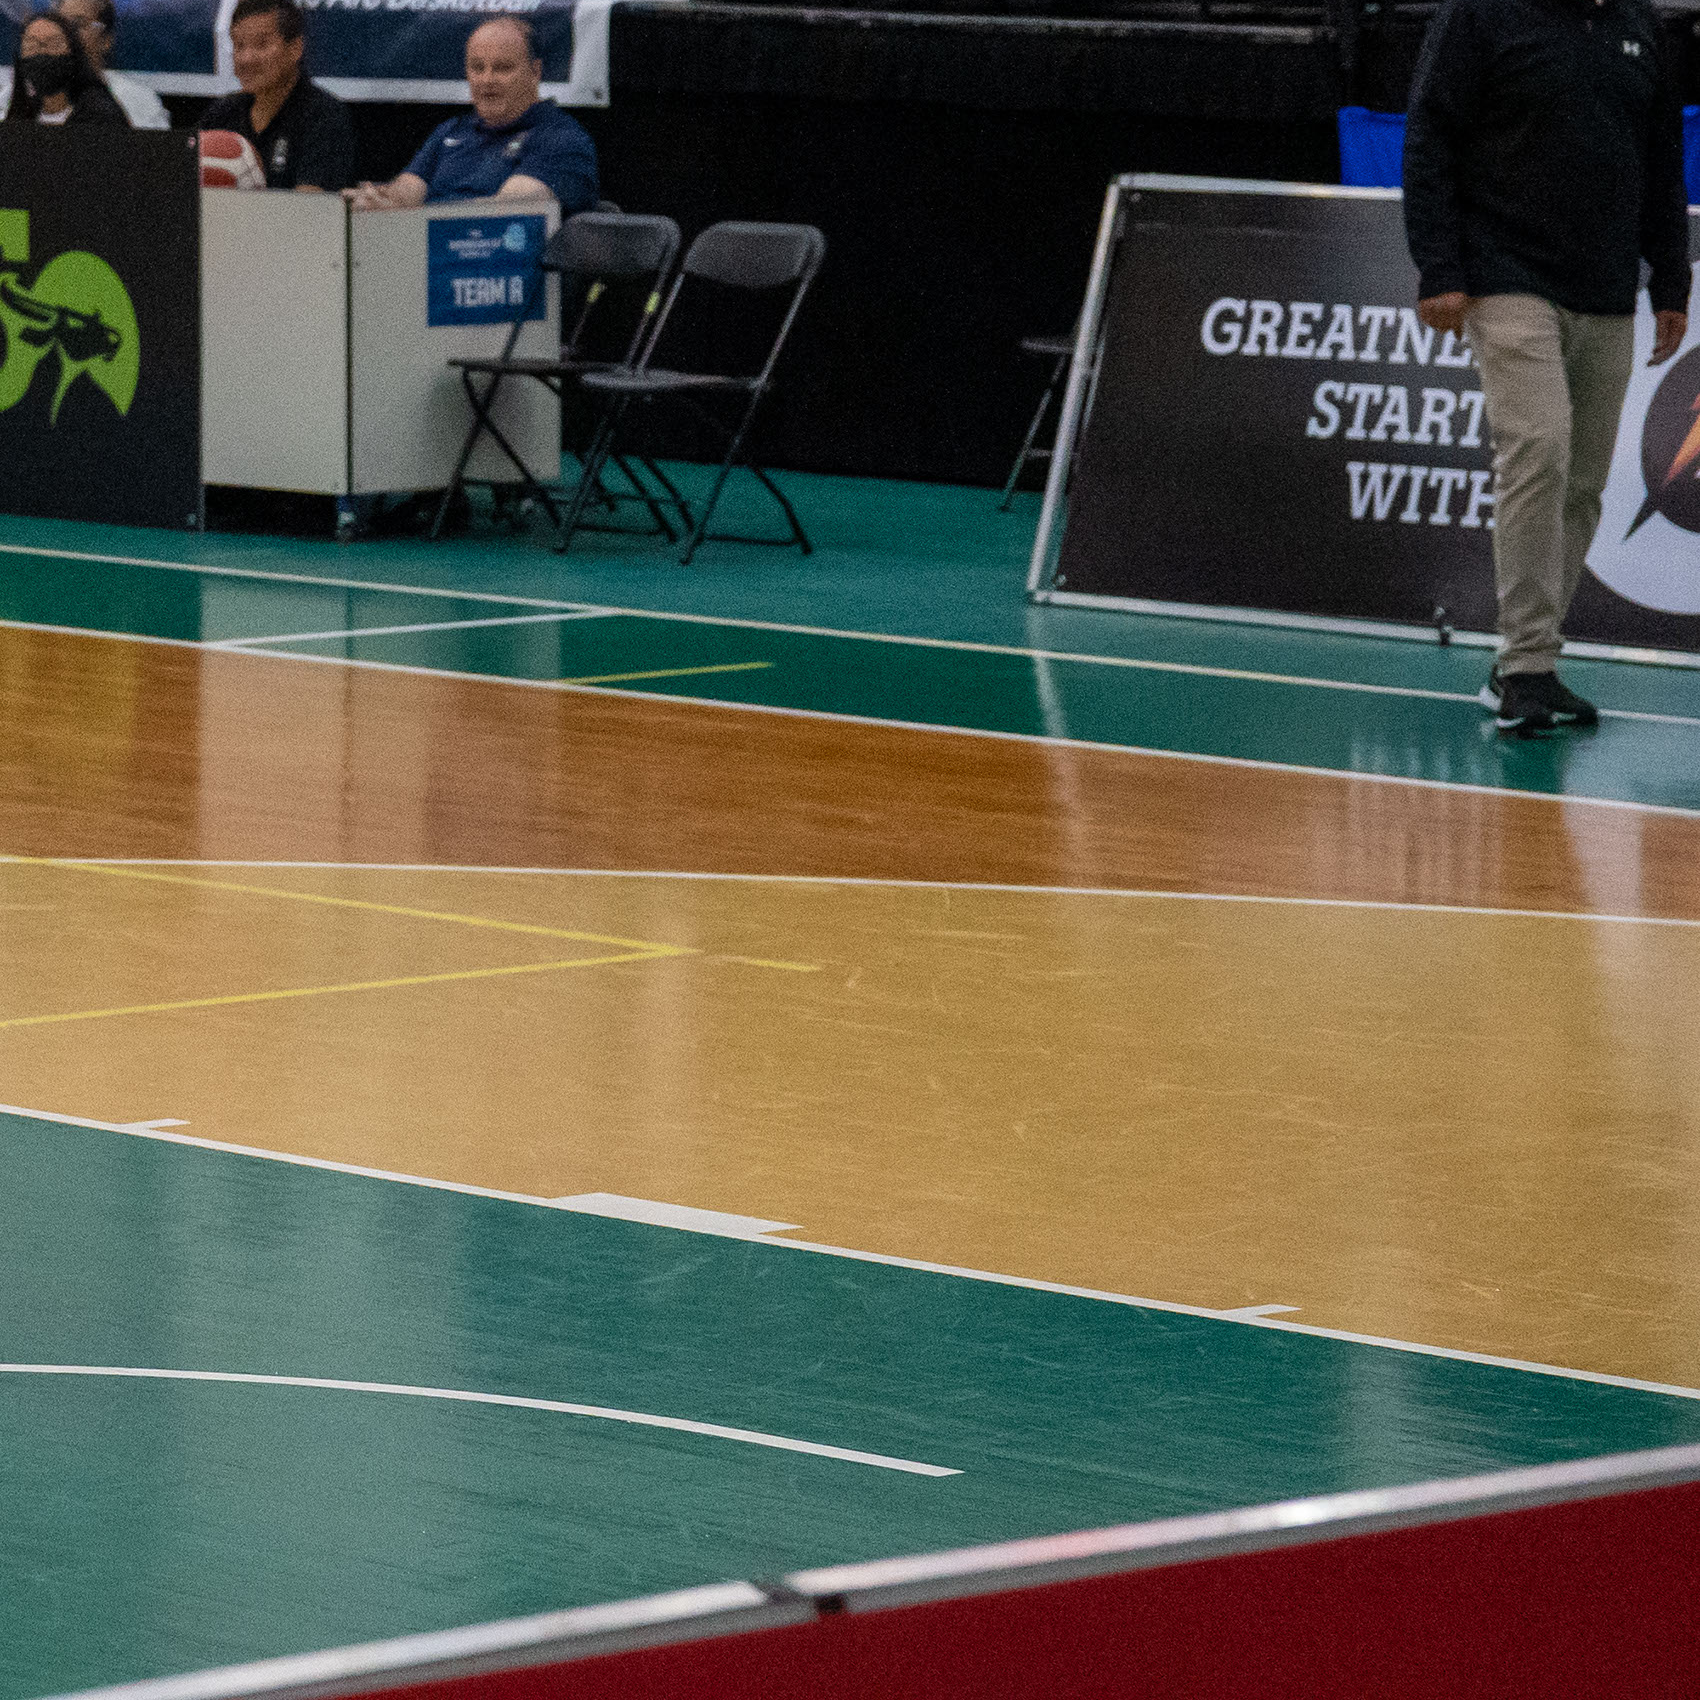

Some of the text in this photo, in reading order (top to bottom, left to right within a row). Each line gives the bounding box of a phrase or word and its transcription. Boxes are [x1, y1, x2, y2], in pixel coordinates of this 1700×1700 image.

[451, 276, 507, 308] TEAM
[1201, 296, 1480, 368] GREATNE
[1305, 380, 1497, 449] START
[1345, 460, 1499, 530] WITH
